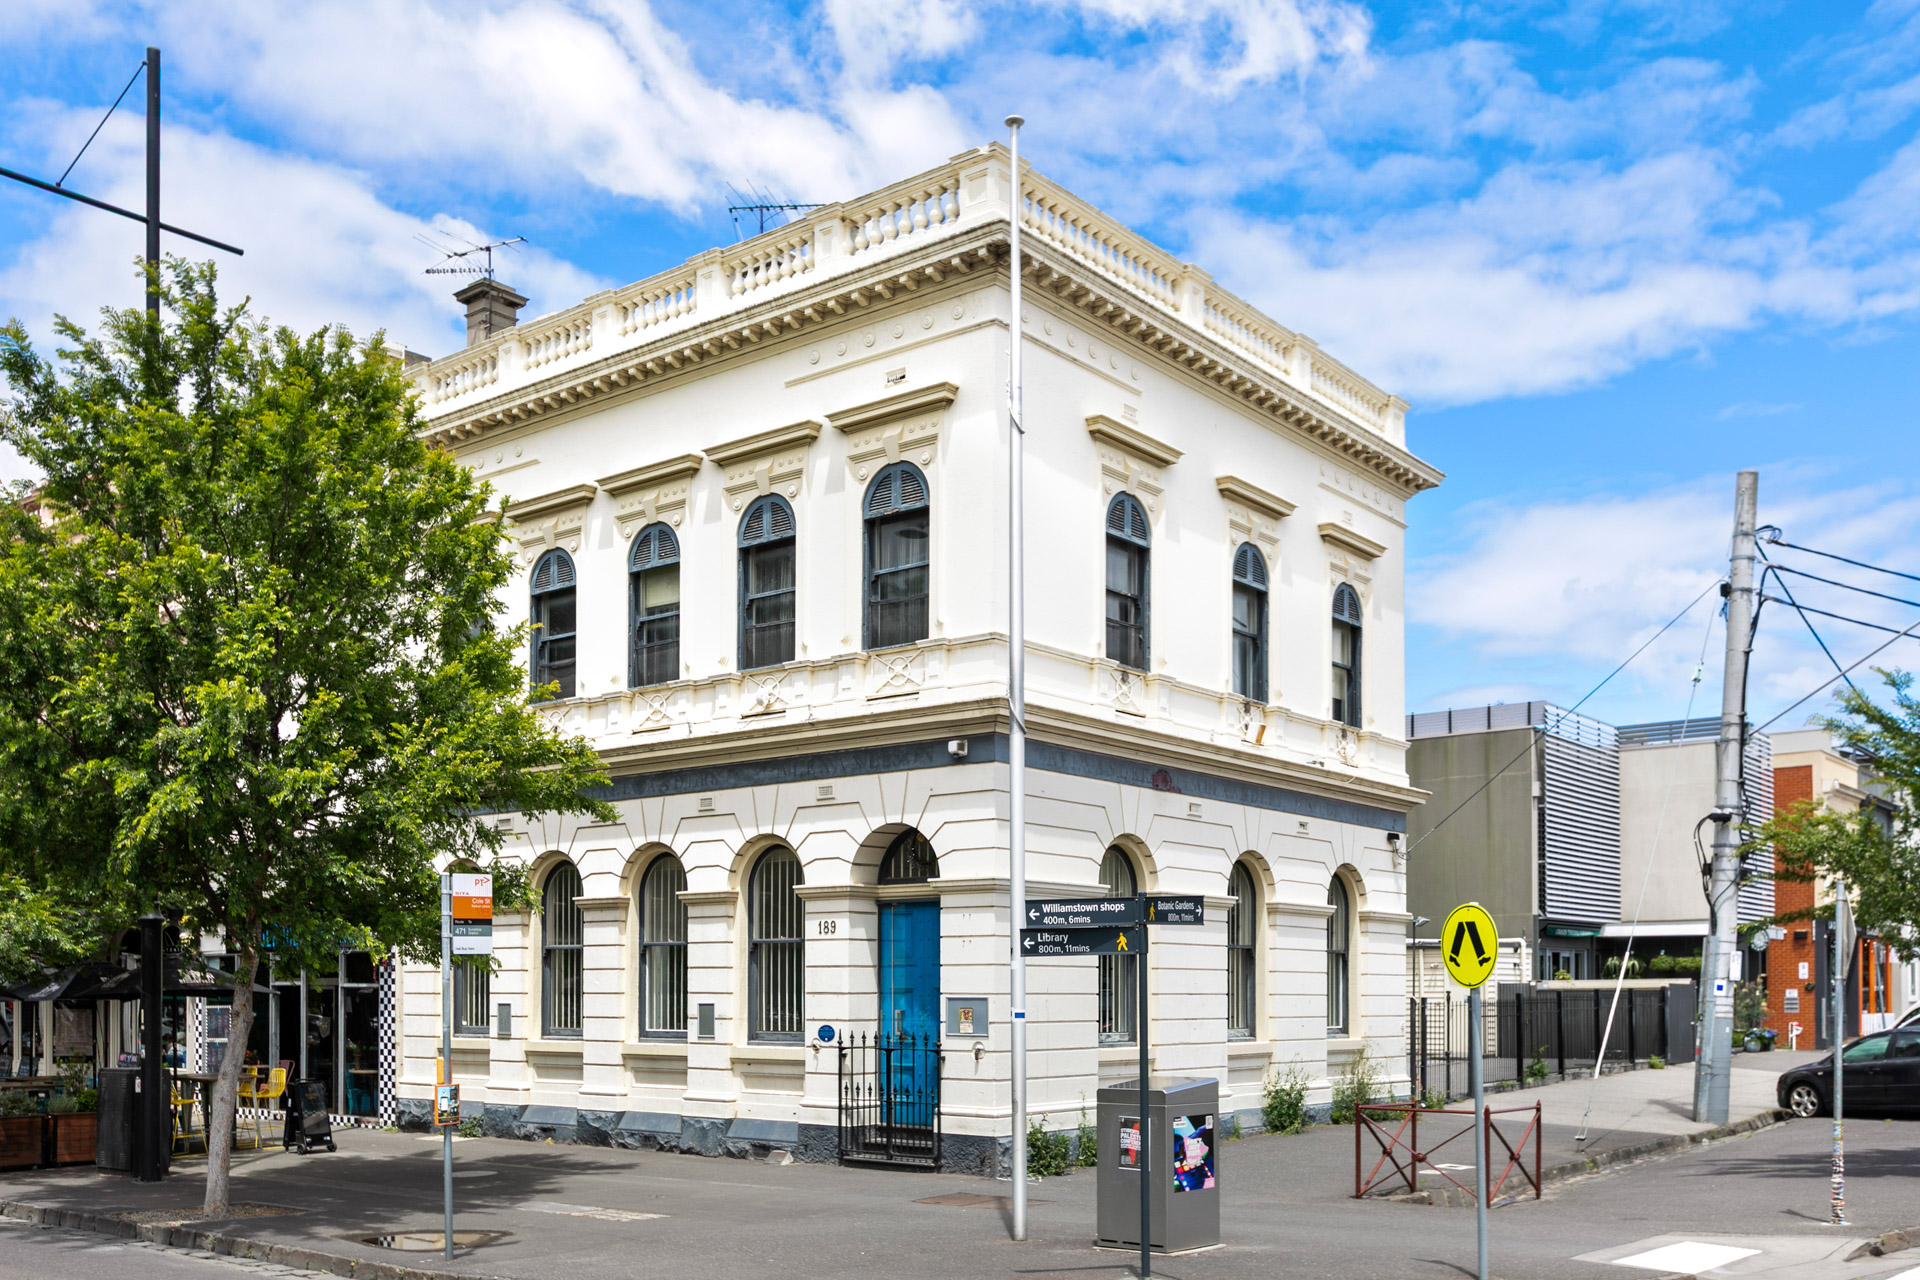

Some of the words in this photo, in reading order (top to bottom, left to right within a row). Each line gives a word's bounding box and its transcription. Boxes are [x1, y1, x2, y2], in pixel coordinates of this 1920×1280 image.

[1041, 903, 1099, 913] Williamstown
[1100, 902, 1125, 913] shops
[1157, 900, 1174, 910] Botanic
[1174, 900, 1194, 910] Gardens
[1043, 916, 1068, 925] 400m,
[1068, 915, 1091, 924] 6mins
[818, 920, 836, 935] 189
[1037, 933, 1069, 944] Library
[1038, 945, 1064, 954] 800m,
[1065, 944, 1090, 953] 11mins
